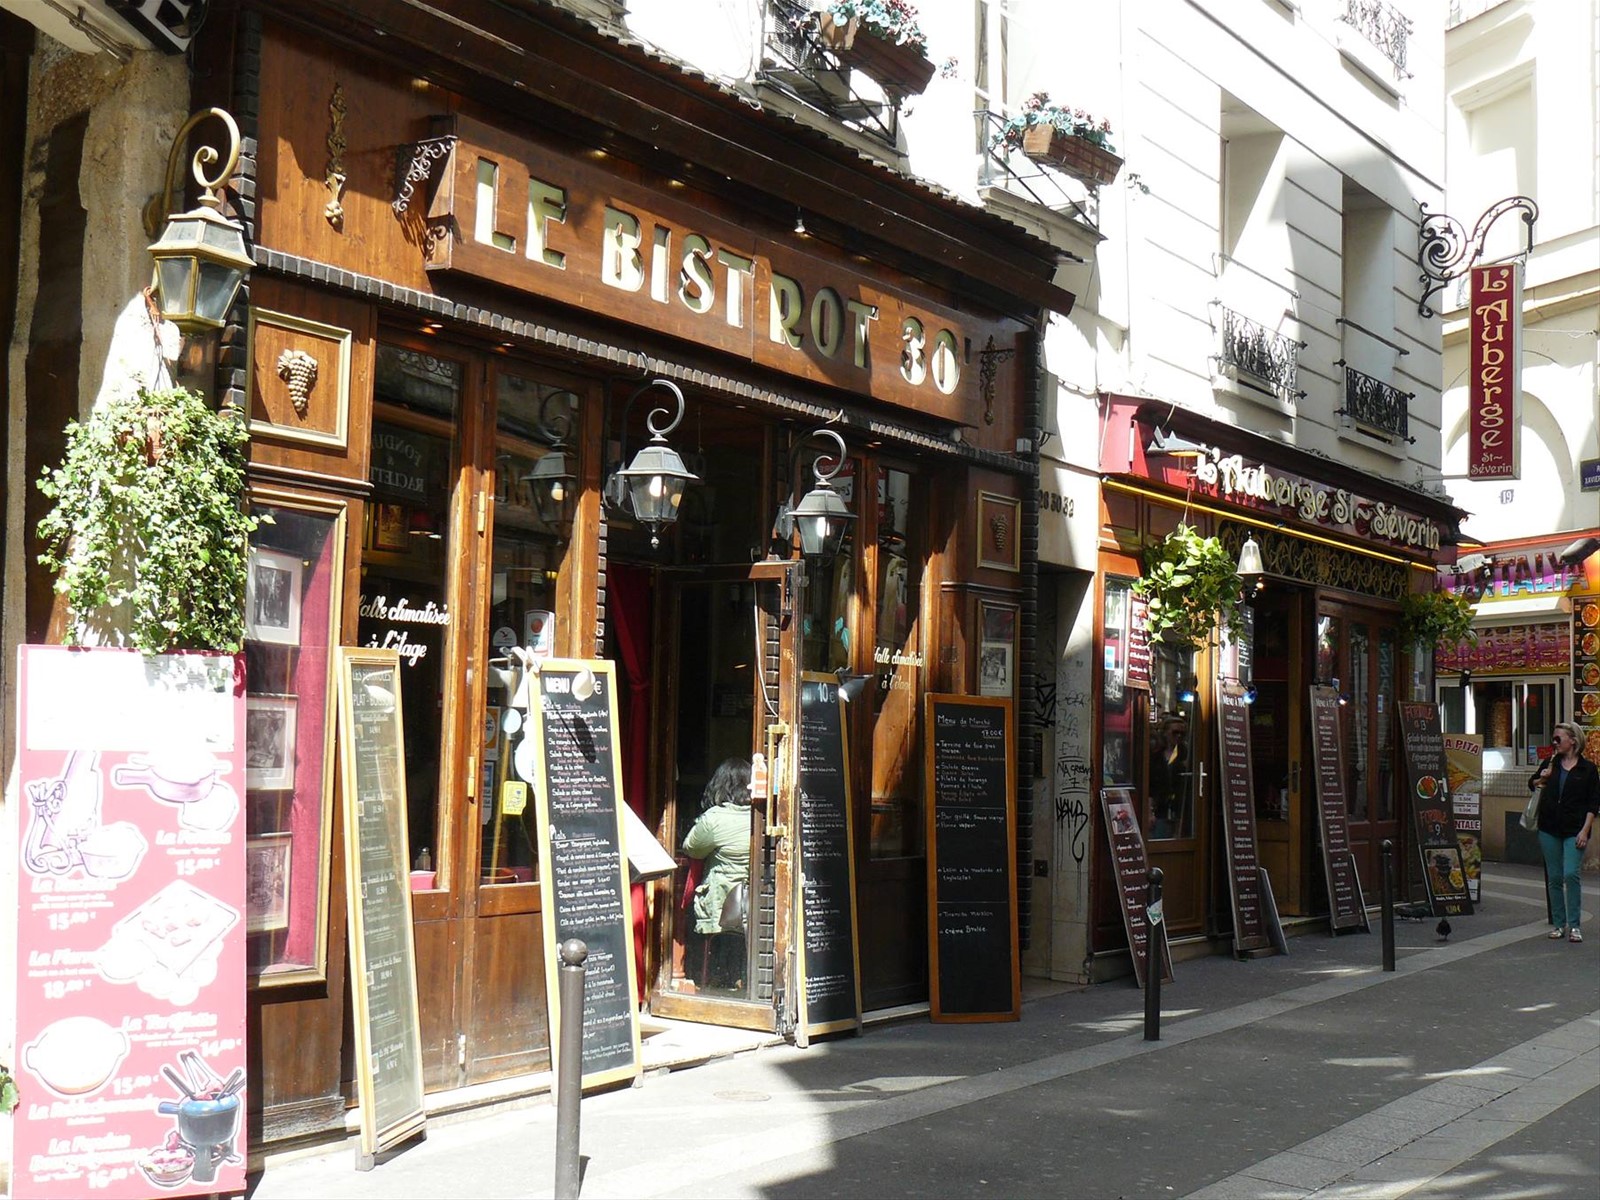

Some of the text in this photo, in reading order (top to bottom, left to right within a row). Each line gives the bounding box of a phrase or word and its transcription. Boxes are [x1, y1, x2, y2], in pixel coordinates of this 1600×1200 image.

[474, 157, 961, 396] LE BISTROT 30
[388, 598, 451, 625] climatisée
[545, 677, 570, 694] MENU
[818, 682, 829, 703] 10
[938, 714, 956, 725] Menu
[1455, 739, 1480, 755] PITA
